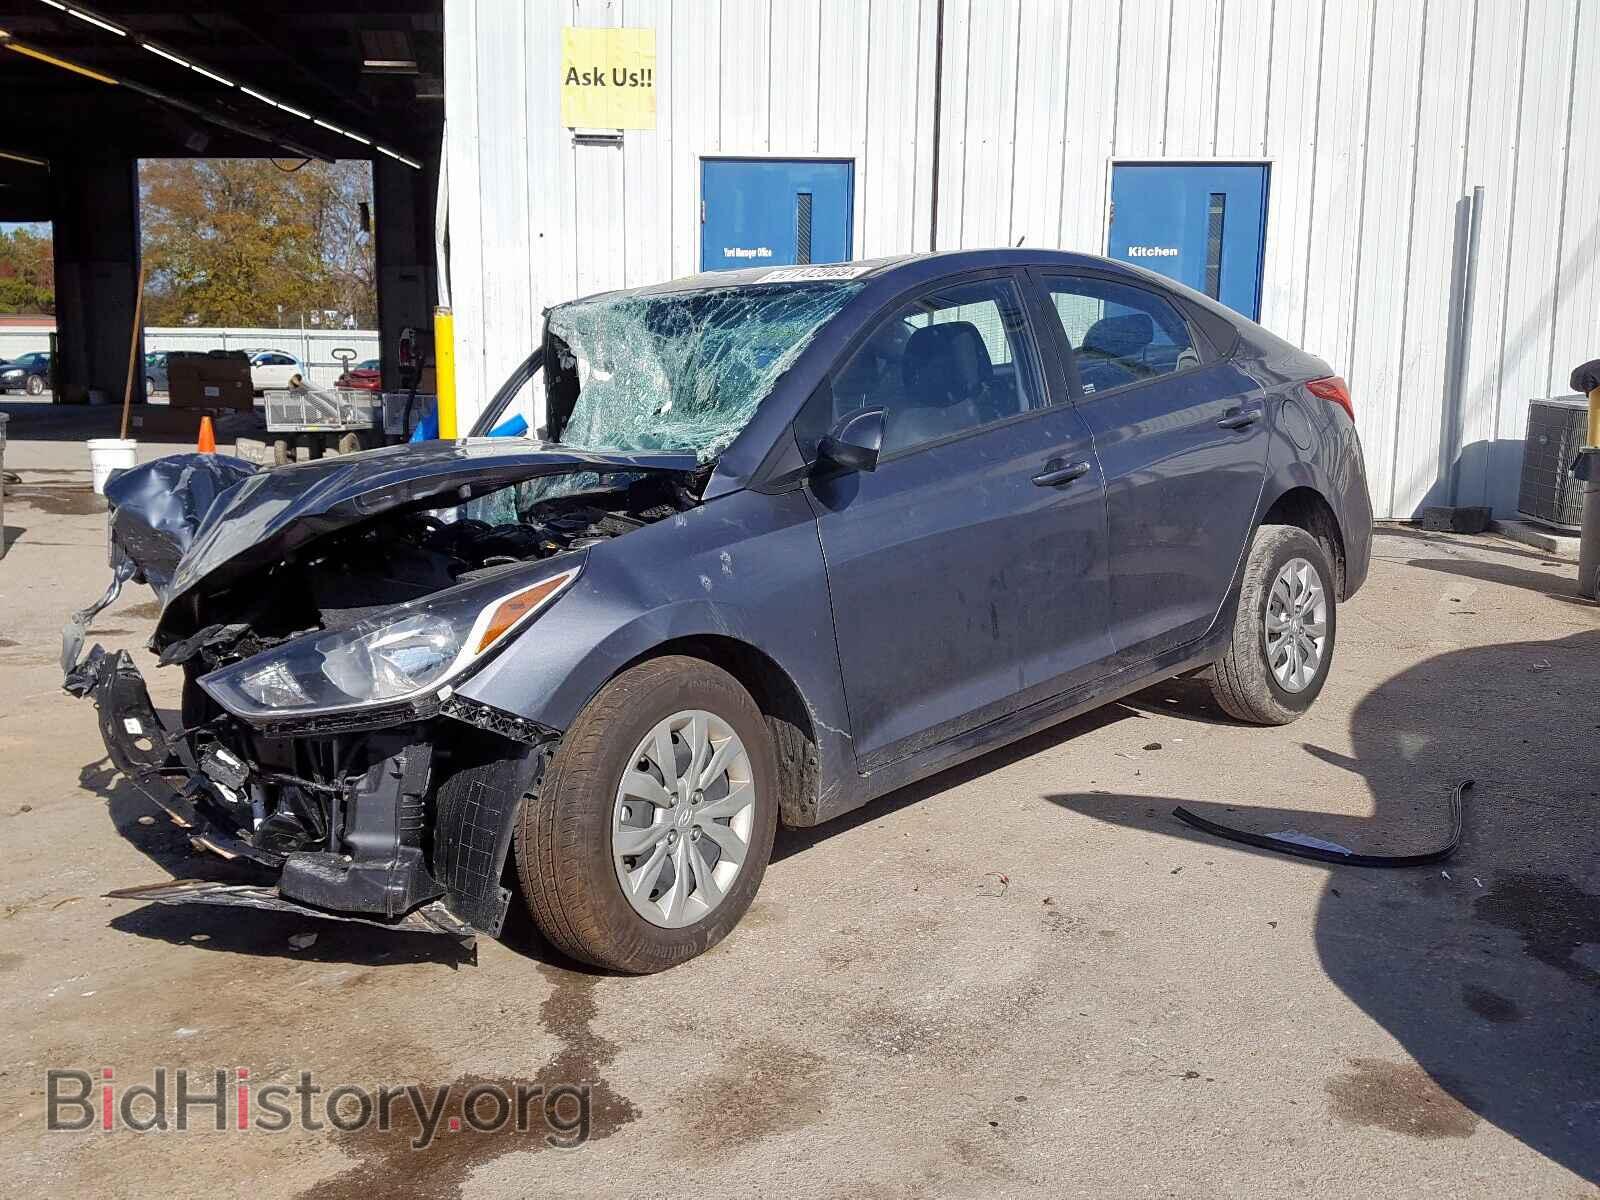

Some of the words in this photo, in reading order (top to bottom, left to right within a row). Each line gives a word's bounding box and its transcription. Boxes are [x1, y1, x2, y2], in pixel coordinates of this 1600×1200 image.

[565, 66, 606, 86] Ask
[612, 67, 652, 87] Us!!
[723, 247, 735, 257] Yard
[736, 247, 757, 260] Manager
[758, 247, 773, 257] Office
[1128, 246, 1178, 257] Kitchen
